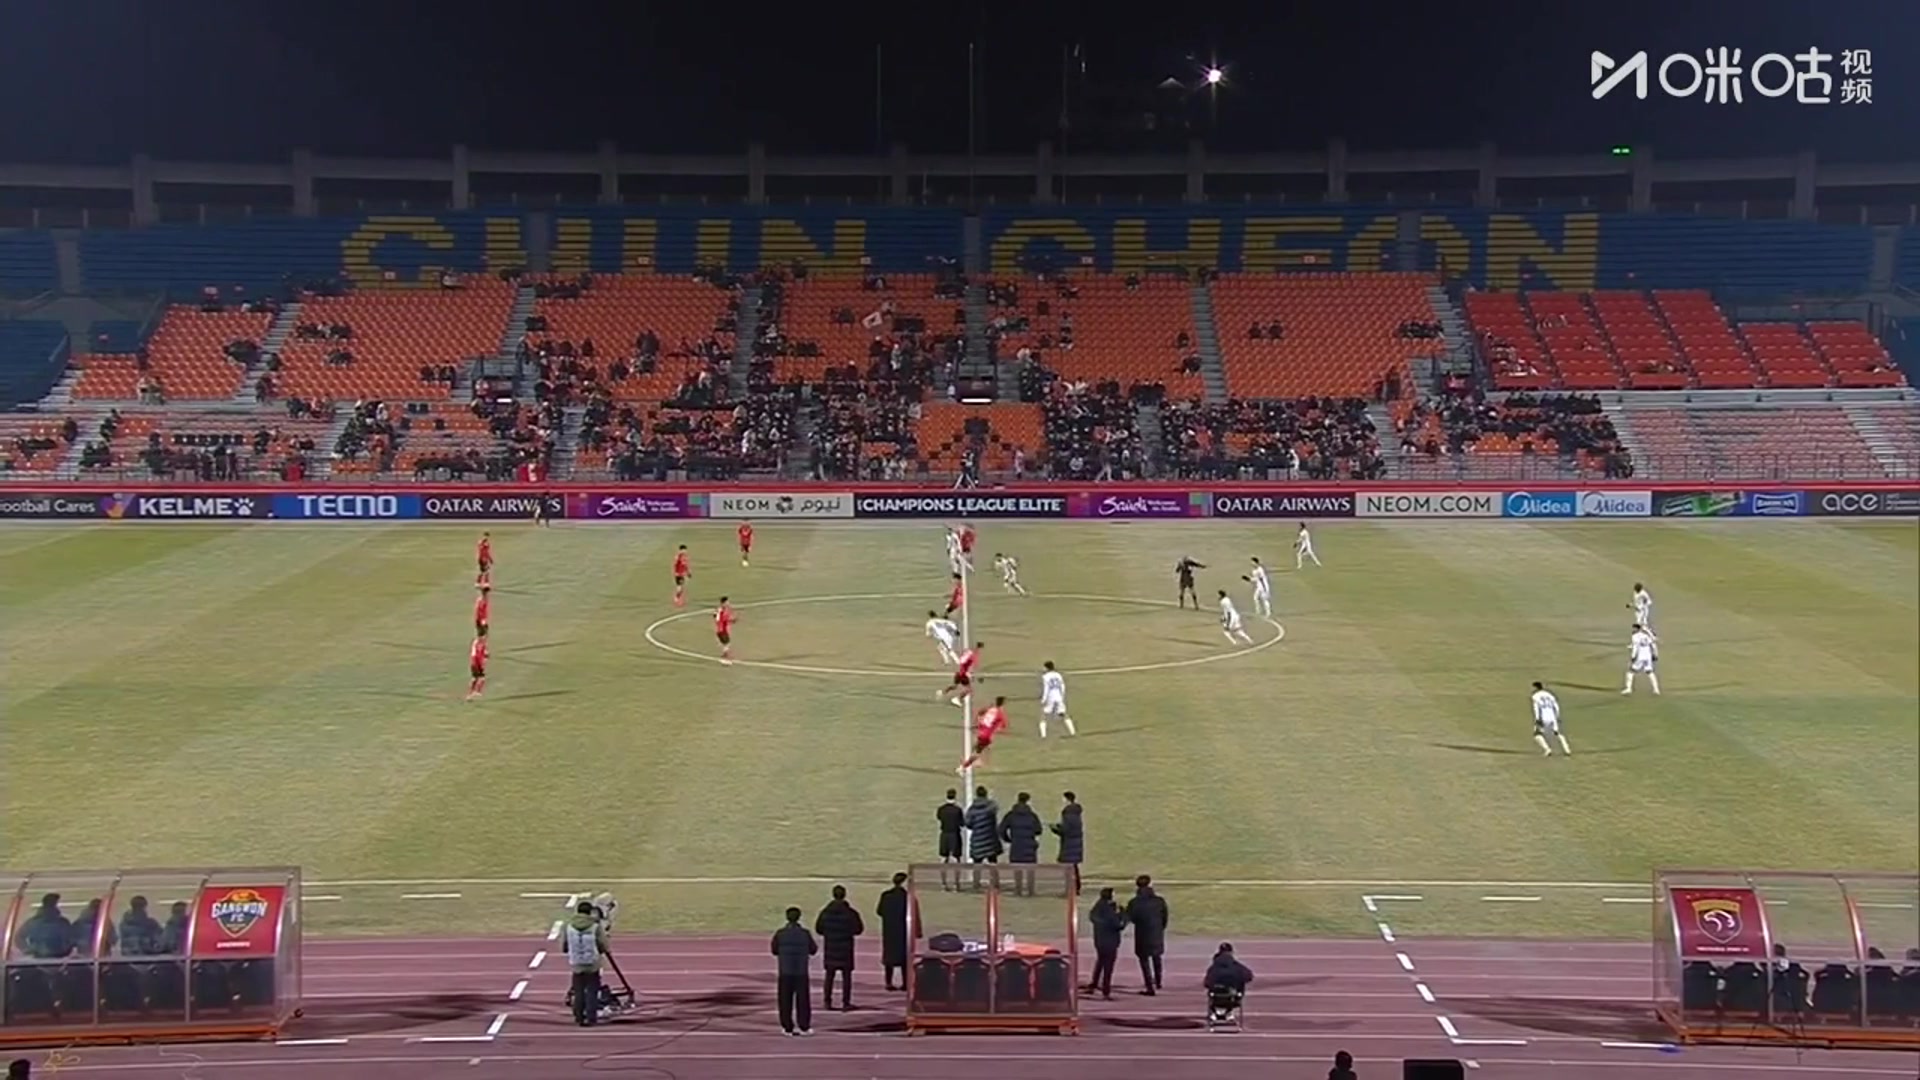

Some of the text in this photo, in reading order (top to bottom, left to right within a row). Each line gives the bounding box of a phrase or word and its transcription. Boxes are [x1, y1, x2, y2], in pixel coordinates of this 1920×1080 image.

[0, 499, 95, 512] ootball Cares
[139, 498, 233, 515] KELME
[298, 495, 397, 516] TECNO
[426, 498, 484, 513] QATAR
[723, 499, 770, 510] NEOM
[863, 498, 1061, 511] CHAMPIONS LEAGUE ELITE
[1217, 497, 1351, 512] QATAR AIRWAYS
[1367, 497, 1491, 513] NEOM.COM
[1519, 498, 1571, 514] Midea
[1593, 498, 1645, 513] Midea
[1822, 493, 1878, 511] ace
